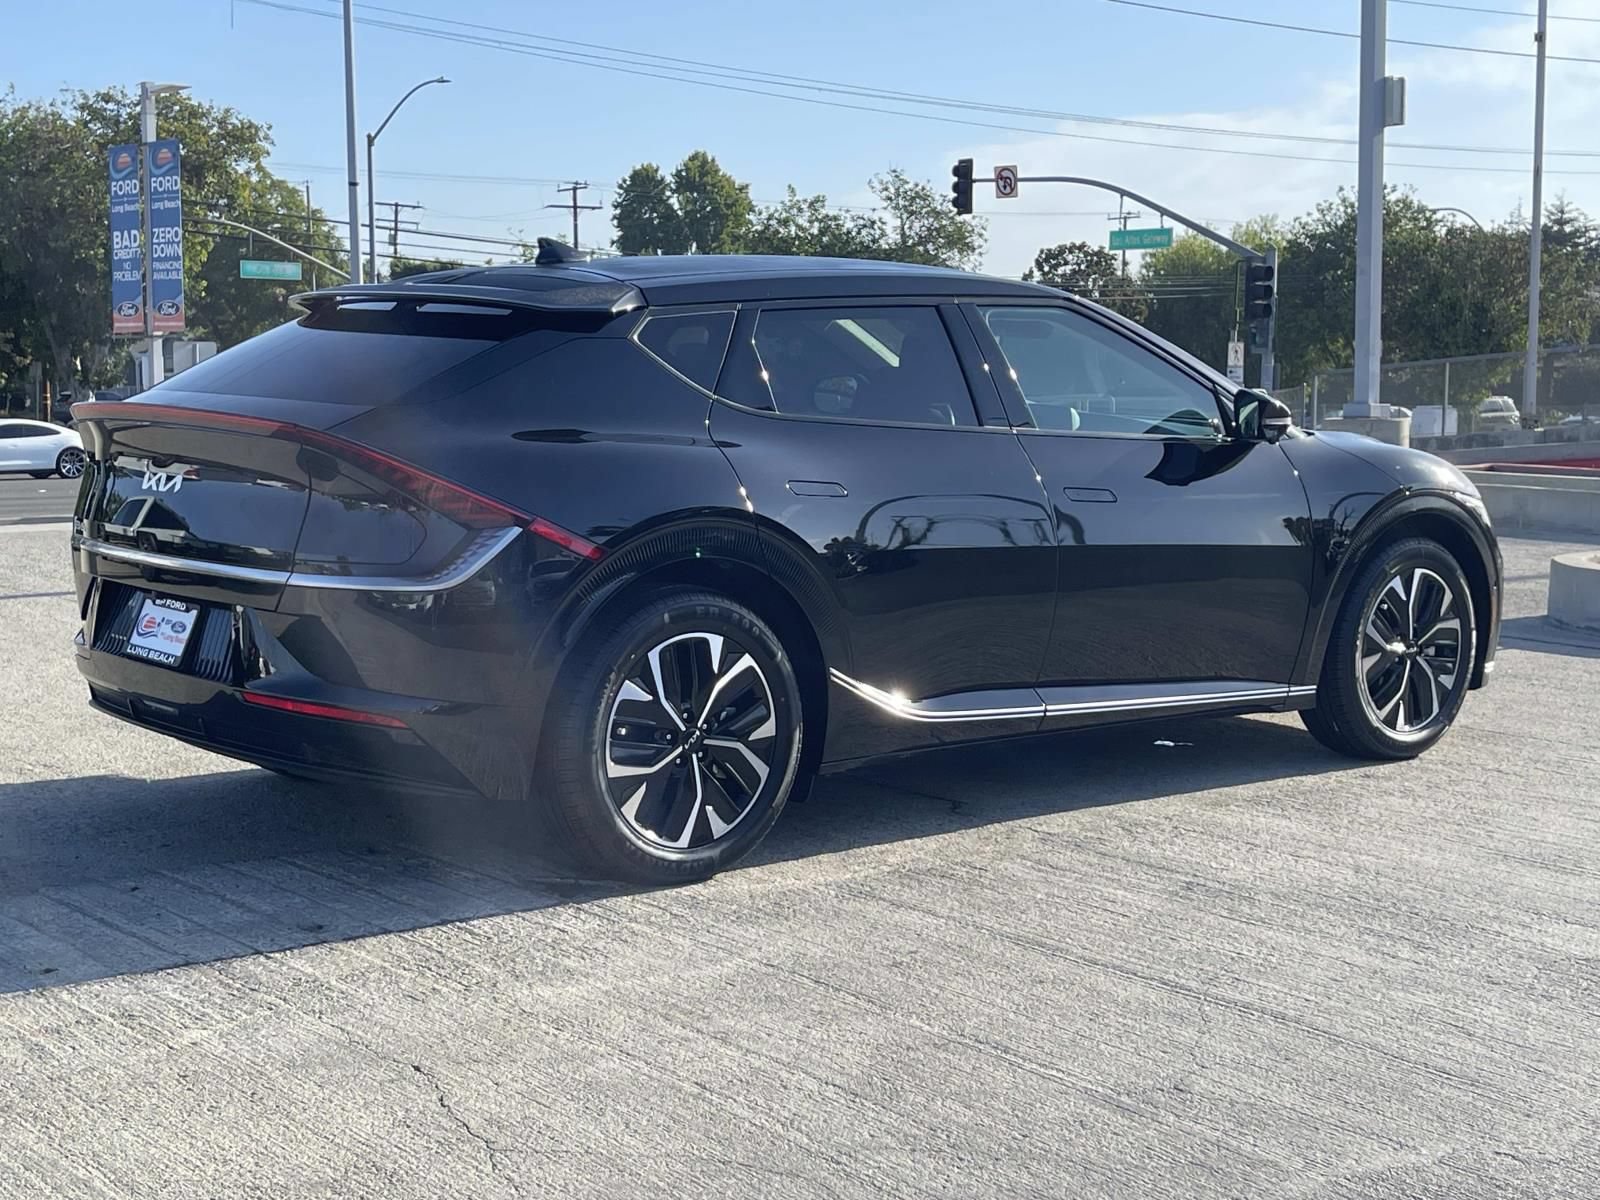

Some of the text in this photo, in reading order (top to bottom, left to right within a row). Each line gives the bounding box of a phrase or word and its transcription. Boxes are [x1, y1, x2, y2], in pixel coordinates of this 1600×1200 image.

[111, 180, 139, 196] FORD
[151, 175, 180, 192] FORD
[112, 203, 140, 213] Long Beach
[151, 199, 180, 210] Long Beach
[113, 229, 140, 249] BAD
[152, 227, 180, 243] ZERO
[113, 248, 141, 260] CREDIT?
[152, 243, 181, 258] DOWN
[153, 271, 182, 280] AVAILABLE
[120, 303, 136, 316] Ford
[160, 302, 177, 315] Ford
[141, 471, 183, 493] KIA
[166, 599, 186, 611] FORD
[148, 651, 175, 664] BEACH
